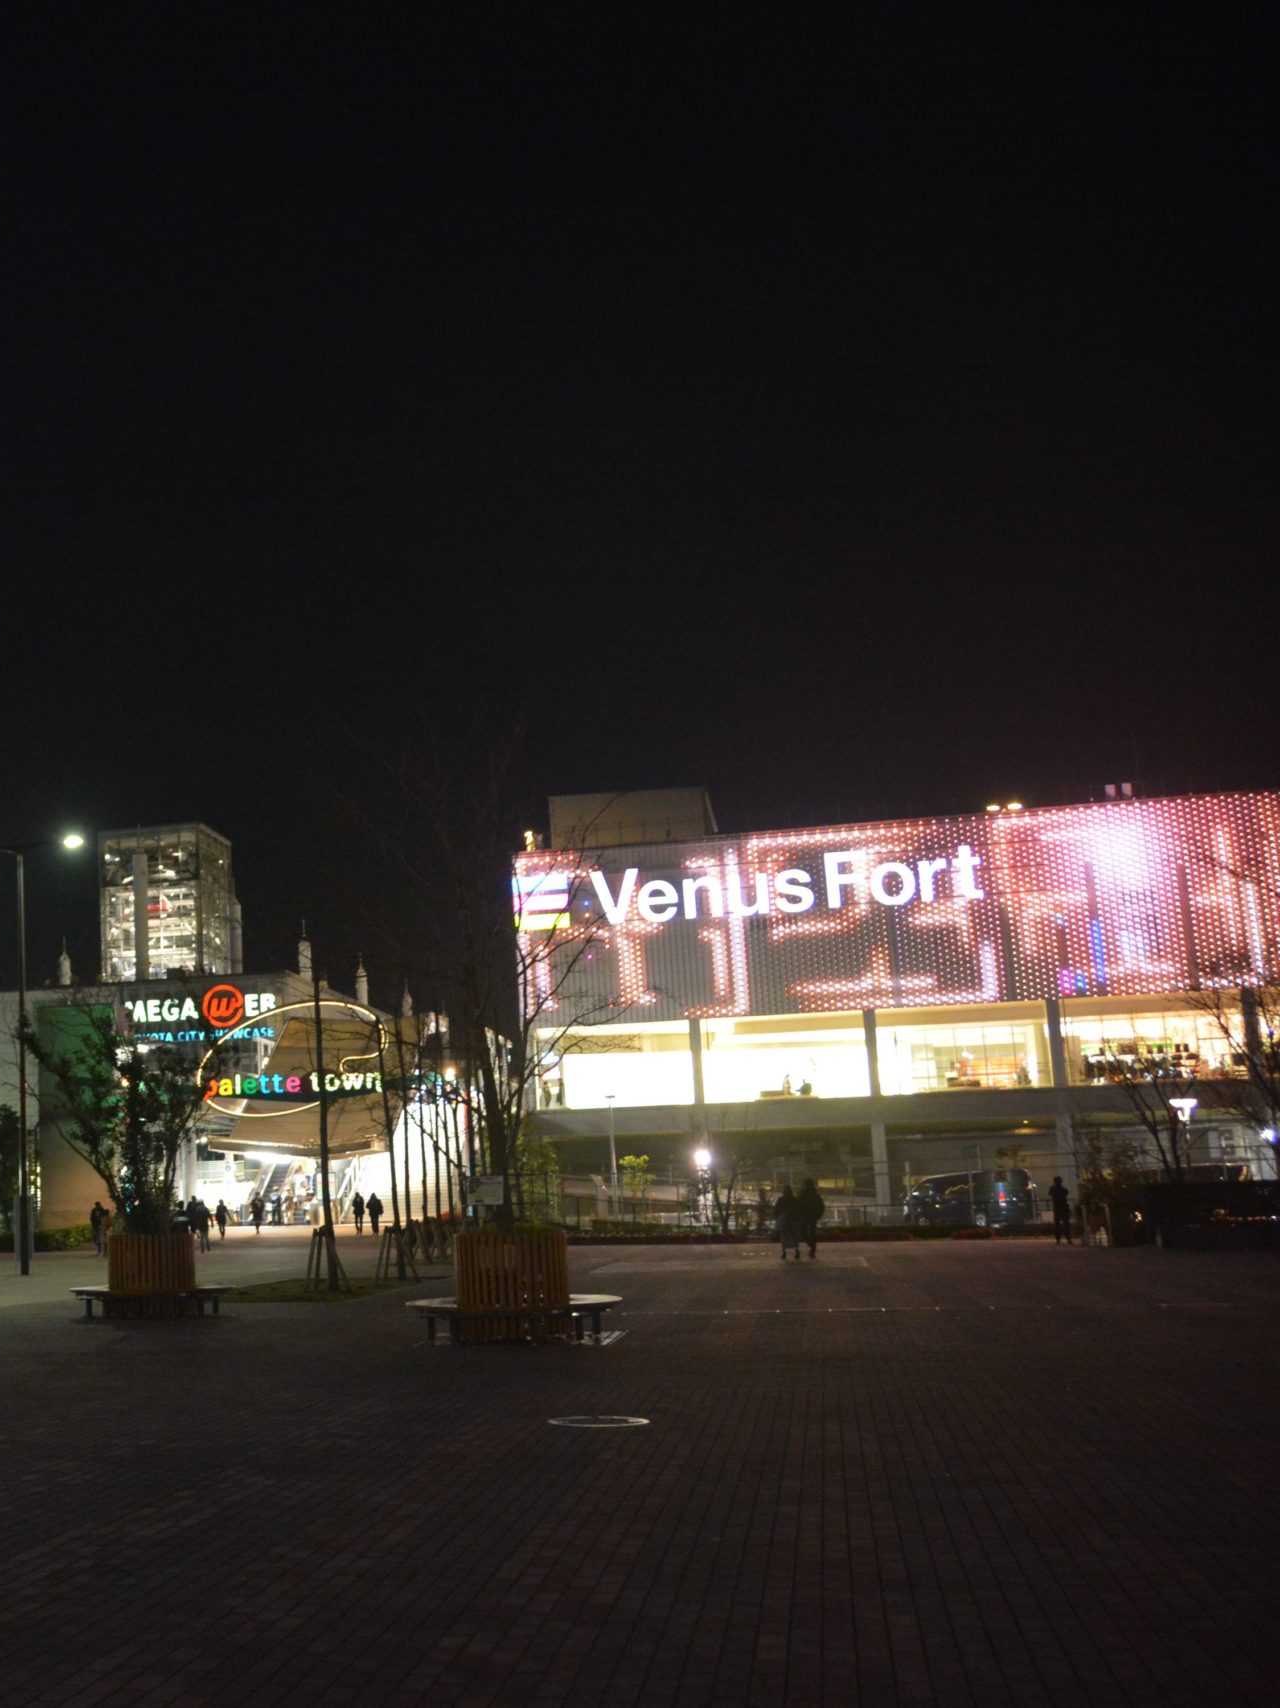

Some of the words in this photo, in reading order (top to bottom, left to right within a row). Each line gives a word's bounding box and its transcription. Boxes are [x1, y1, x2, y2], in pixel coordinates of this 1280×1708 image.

[590, 867, 816, 925] Venus
[823, 844, 985, 909] Fort
[124, 996, 199, 1023] MEGA
[177, 1030, 205, 1042] CITY
[309, 1071, 383, 1093] town
